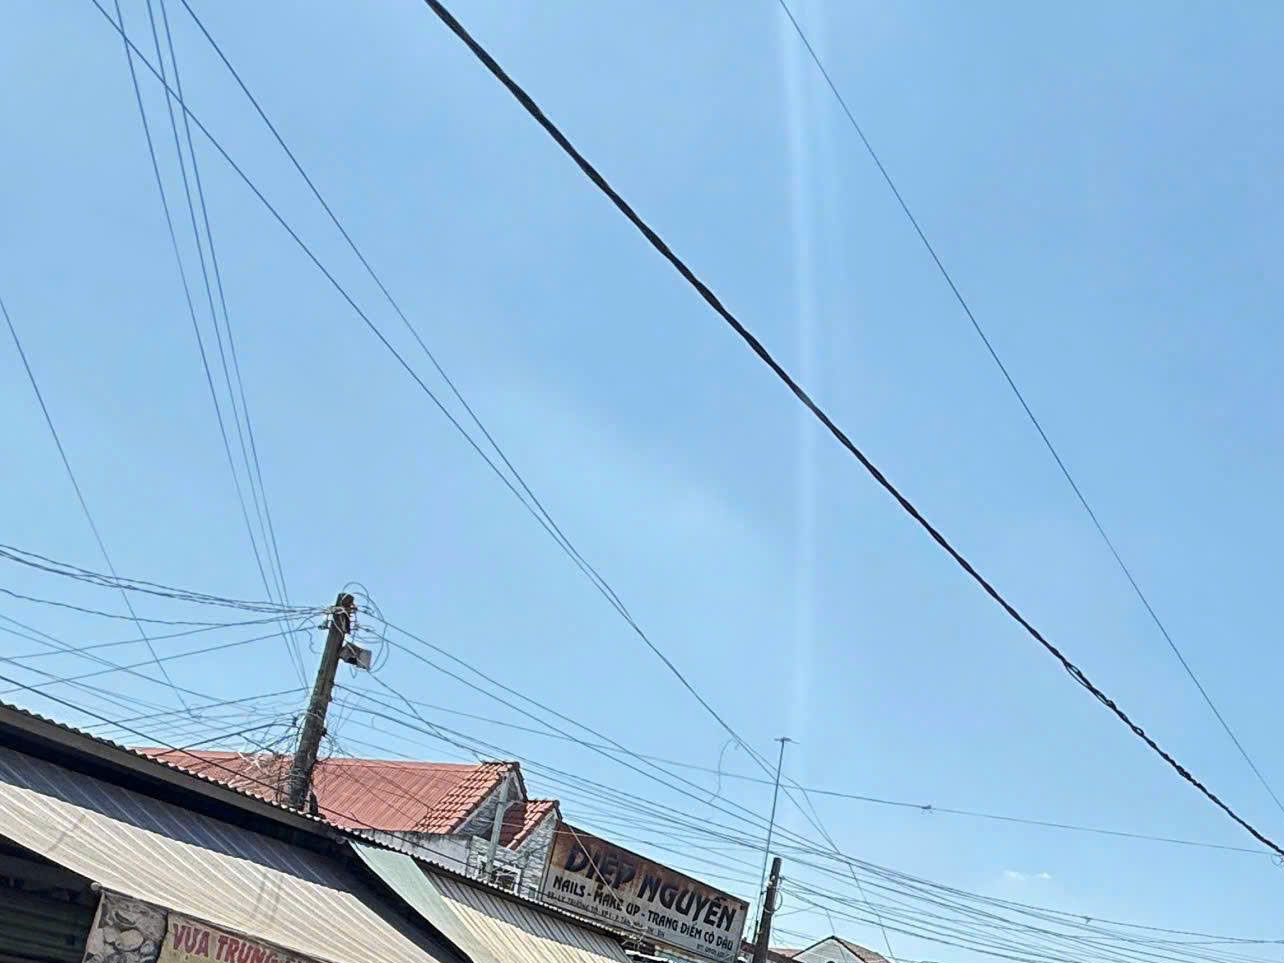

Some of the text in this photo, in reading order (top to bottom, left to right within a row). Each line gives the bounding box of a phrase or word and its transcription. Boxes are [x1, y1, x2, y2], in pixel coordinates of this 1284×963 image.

[552, 875, 586, 897] NAILS
[593, 890, 624, 911] MAKE
[625, 902, 641, 916] UP
[647, 910, 679, 932] TRANG
